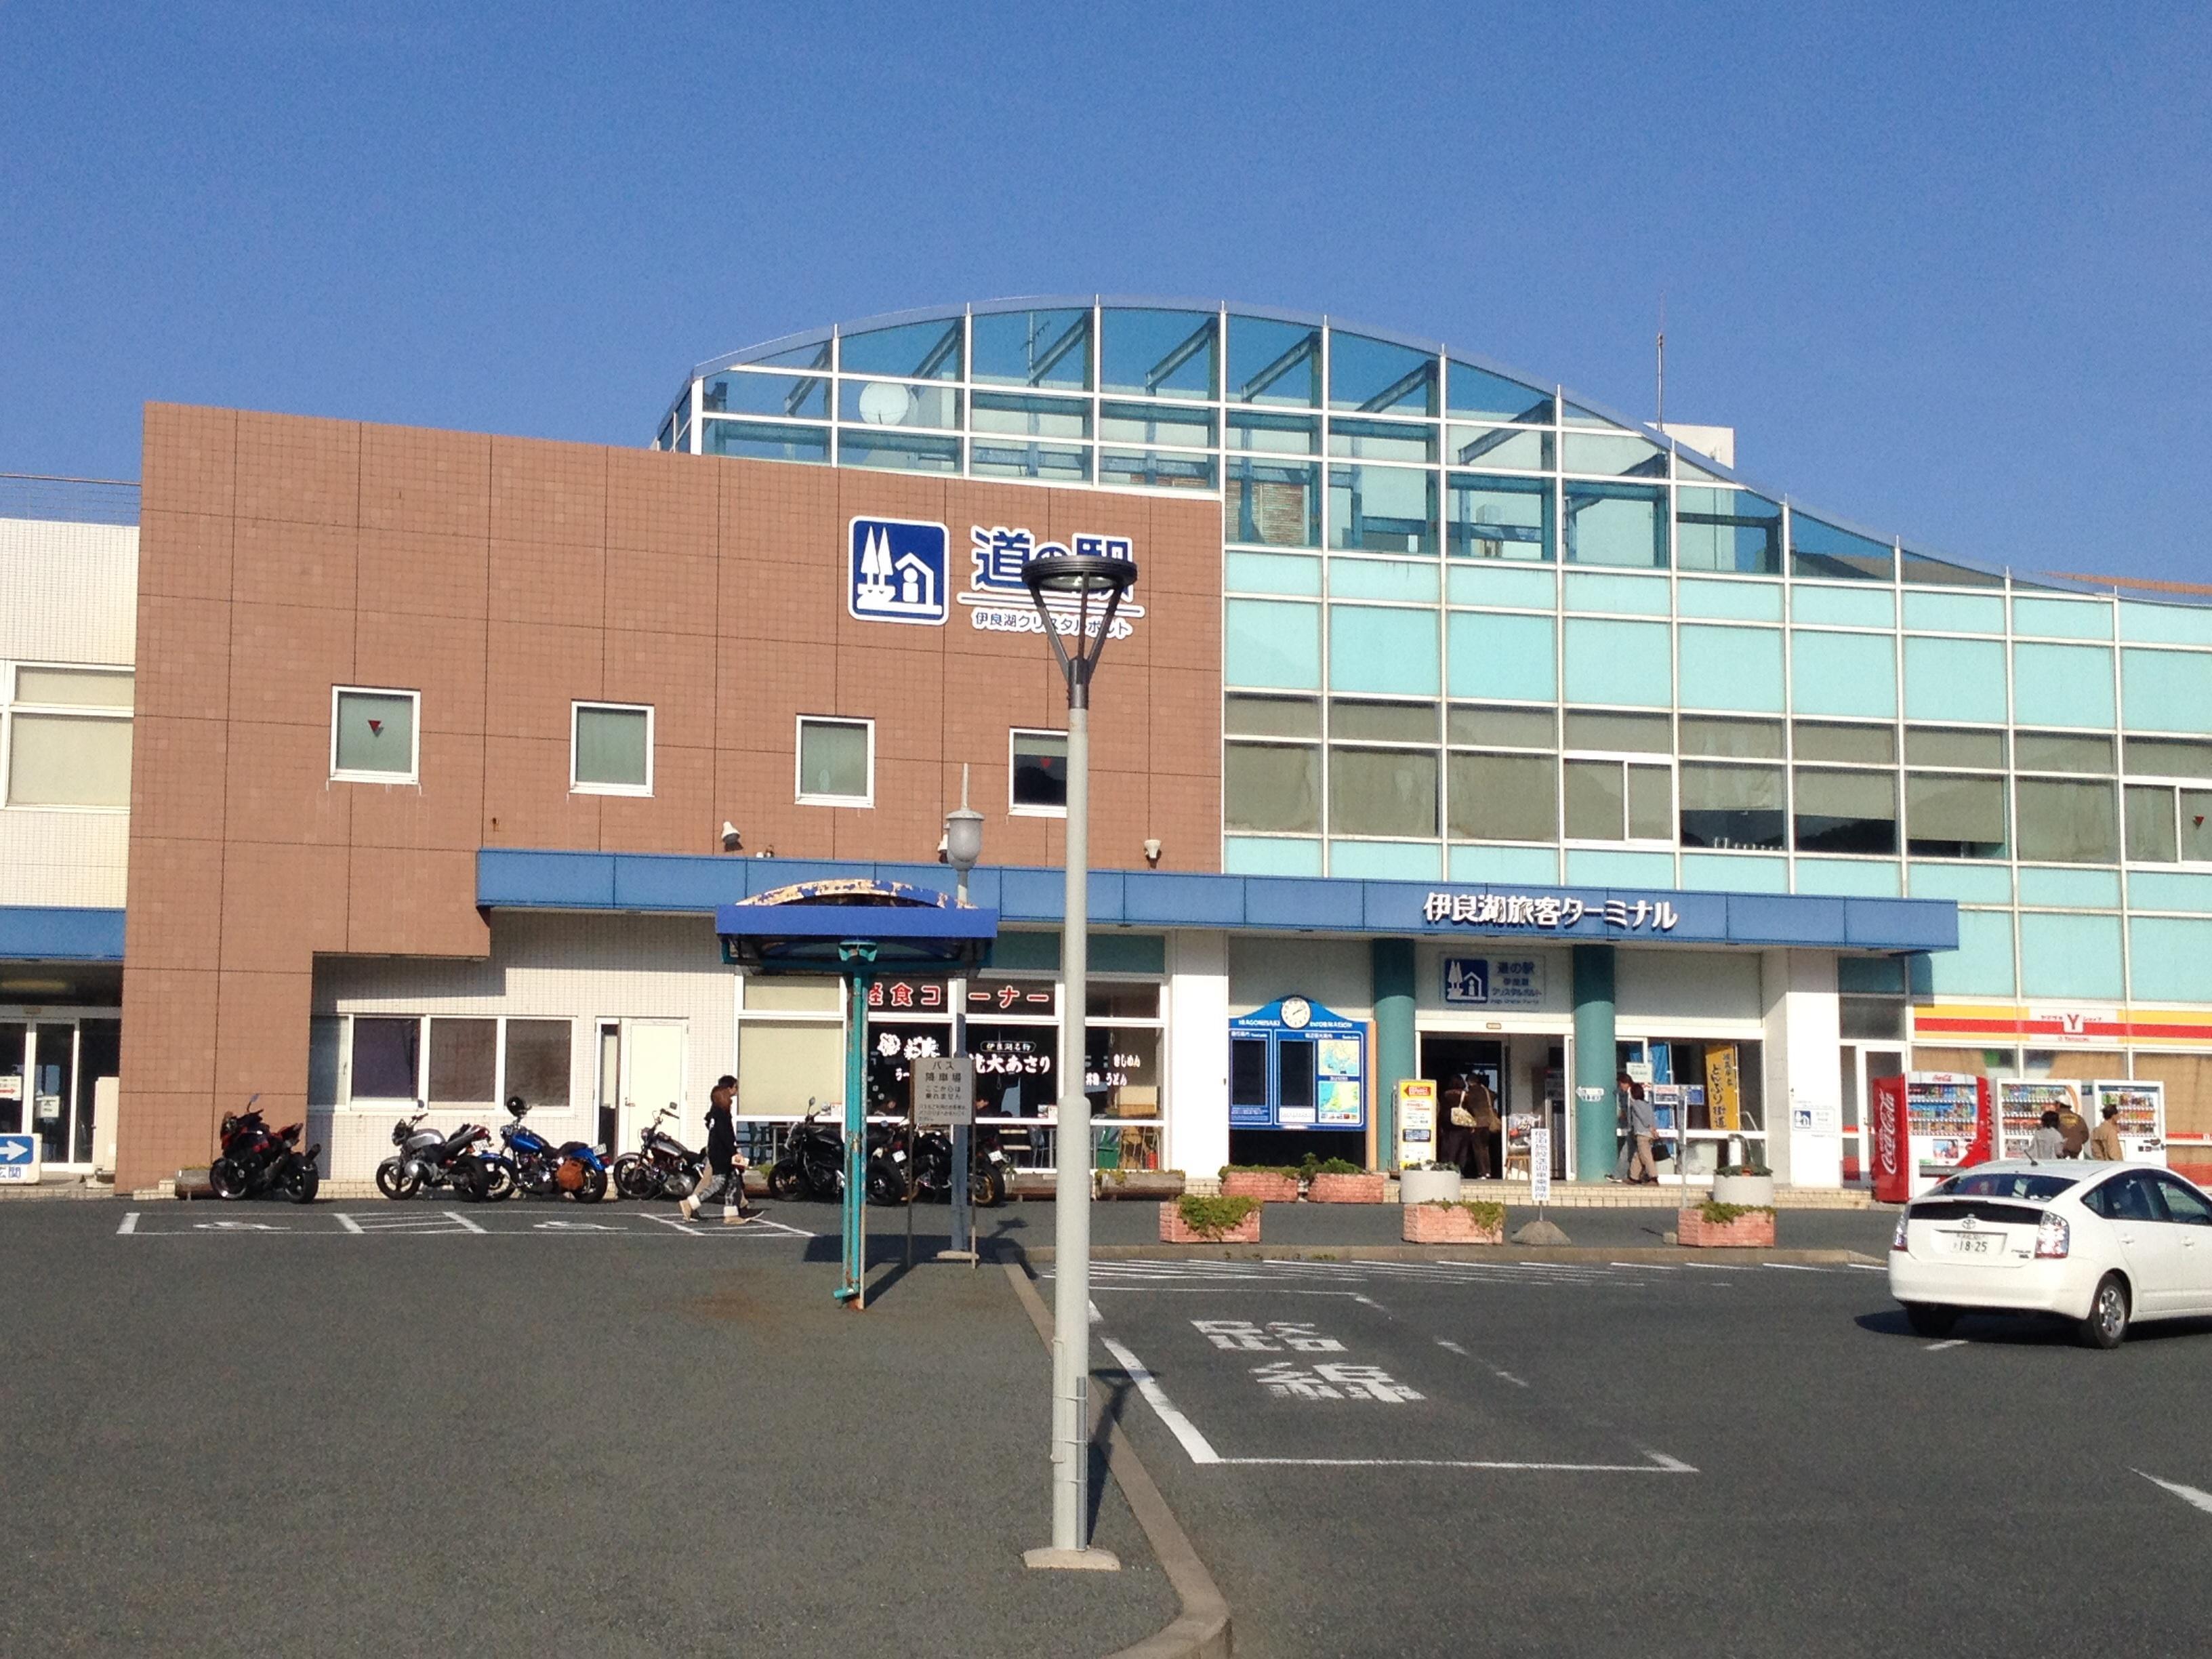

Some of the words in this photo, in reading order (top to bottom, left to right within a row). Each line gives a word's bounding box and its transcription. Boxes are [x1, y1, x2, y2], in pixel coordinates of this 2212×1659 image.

[1424, 893, 1678, 930] 伊良湖旅客ターミナル
[933, 1061, 954, 1070] バス
